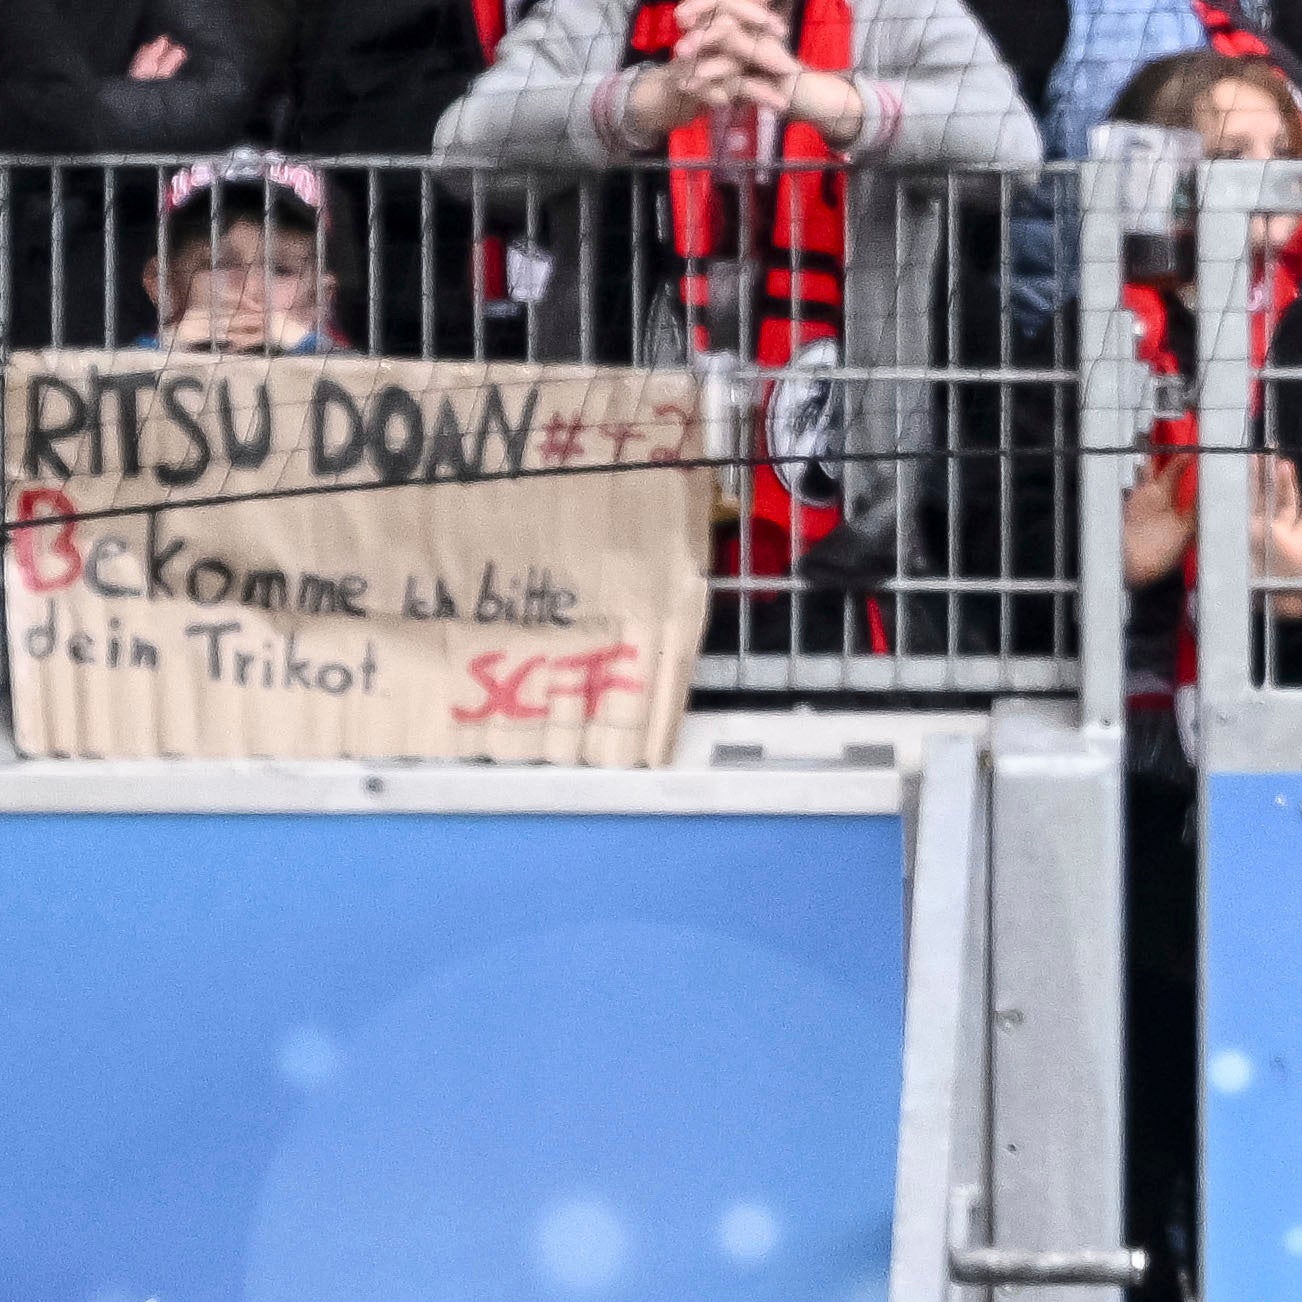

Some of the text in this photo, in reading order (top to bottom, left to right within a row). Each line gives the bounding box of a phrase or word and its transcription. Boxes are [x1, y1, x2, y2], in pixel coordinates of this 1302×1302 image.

[23, 364, 272, 487] RITSU
[310, 378, 539, 485] DOAN
[472, 560, 581, 627] bitte
[24, 597, 378, 697] dein Trikot
